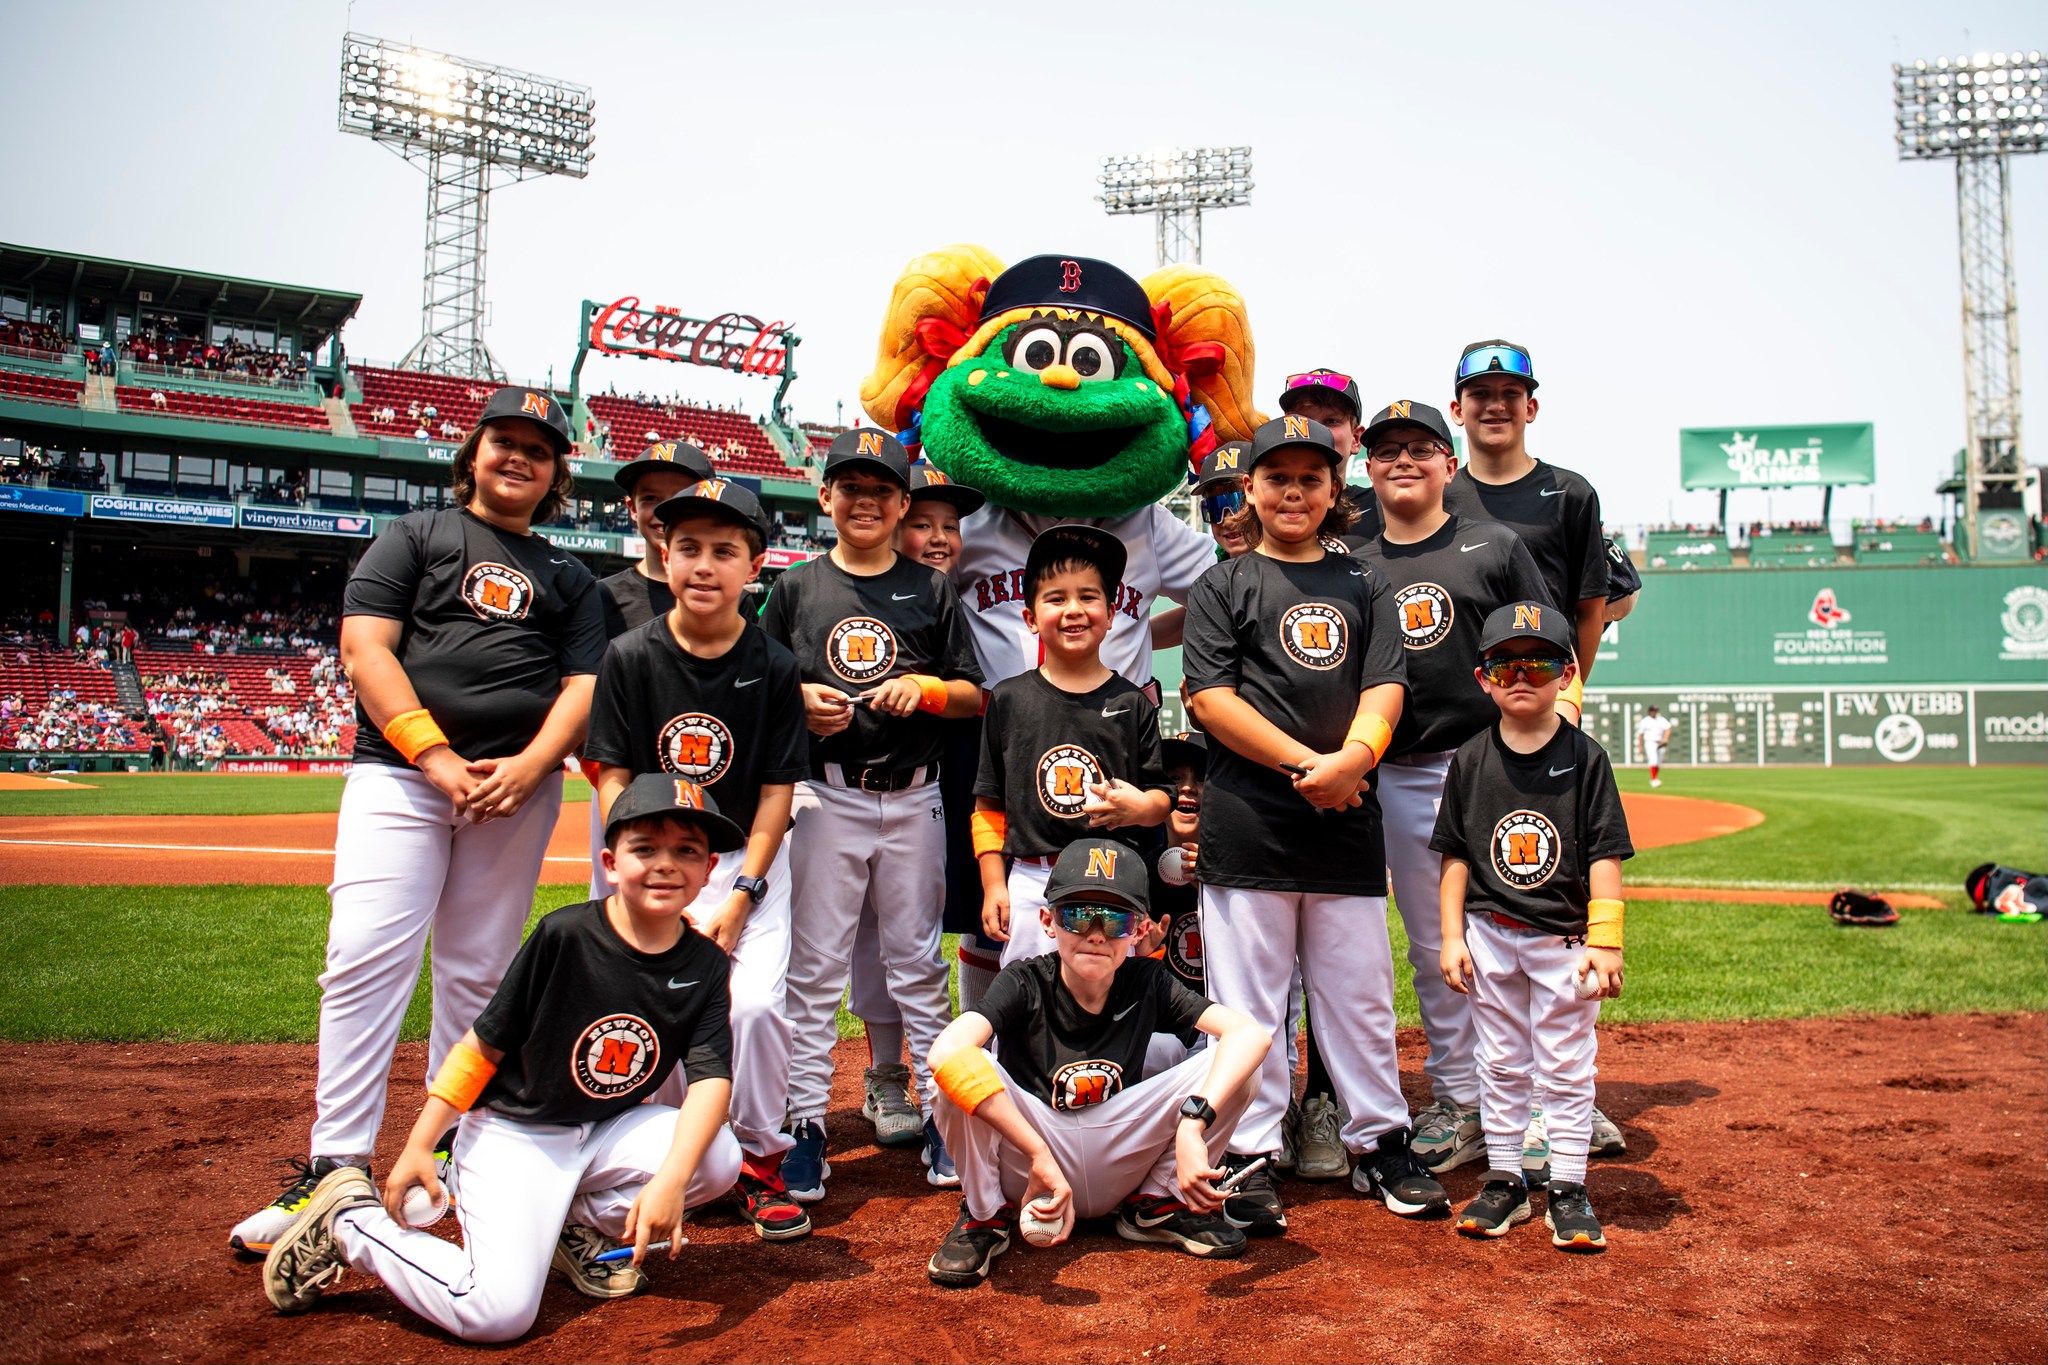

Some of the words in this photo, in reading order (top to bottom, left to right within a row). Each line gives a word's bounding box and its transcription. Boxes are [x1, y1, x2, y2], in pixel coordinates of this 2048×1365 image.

[1059, 260, 1082, 293] B
[591, 295, 796, 376] Coca-Cola
[522, 392, 549, 420] N
[1388, 401, 1411, 419] N
[1284, 416, 1310, 439] N
[652, 443, 677, 462] N
[856, 432, 884, 457] N
[1215, 448, 1240, 471] N
[696, 479, 726, 501] N
[924, 470, 947, 485] N
[19, 502, 44, 511] Medical
[44, 503, 65, 513] Center
[94, 498, 153, 512] COGHLIN
[154, 503, 233, 518] COMPANIES
[246, 511, 299, 527] vineyard
[301, 516, 334, 529] vines
[550, 535, 607, 550] BALLPARK
[473, 566, 528, 592] NEWTON
[481, 578, 514, 612] N
[1285, 607, 1342, 626] NEWTON
[1404, 599, 1436, 631] N
[1513, 604, 1541, 631] N
[834, 621, 891, 642] NEWTON
[1298, 621, 1331, 650] N
[1424, 616, 1449, 644] LEAGUE
[846, 635, 877, 662] N
[1287, 640, 1314, 664] LITTLE
[1774, 639, 1887, 654] FOUNDATION
[833, 655, 857, 678] LITTLE
[862, 655, 892, 678] LEAGUE
[1884, 692, 1964, 715] WEBB
[665, 717, 728, 743] NEWTON
[1984, 711, 2048, 735] mod
[678, 733, 713, 767] N
[1041, 749, 1098, 774] NEWTON
[227, 761, 289, 773] Safelite
[1054, 765, 1085, 796] N
[674, 779, 705, 810] N
[1041, 788, 1064, 812] LITTLE
[1496, 814, 1554, 840] NEWTON
[1508, 832, 1540, 865] N
[1085, 848, 1117, 879] N
[1496, 857, 1520, 883] LITTLE
[1525, 856, 1555, 883] LEAGUE
[588, 1019, 655, 1052] NEWTON
[594, 1037, 639, 1077] N
[578, 1060, 601, 1092] LITTLE
[606, 1071, 647, 1093] LEAGUE
[1058, 1063, 1120, 1084] NEWTON
[1071, 1075, 1107, 1106] N
